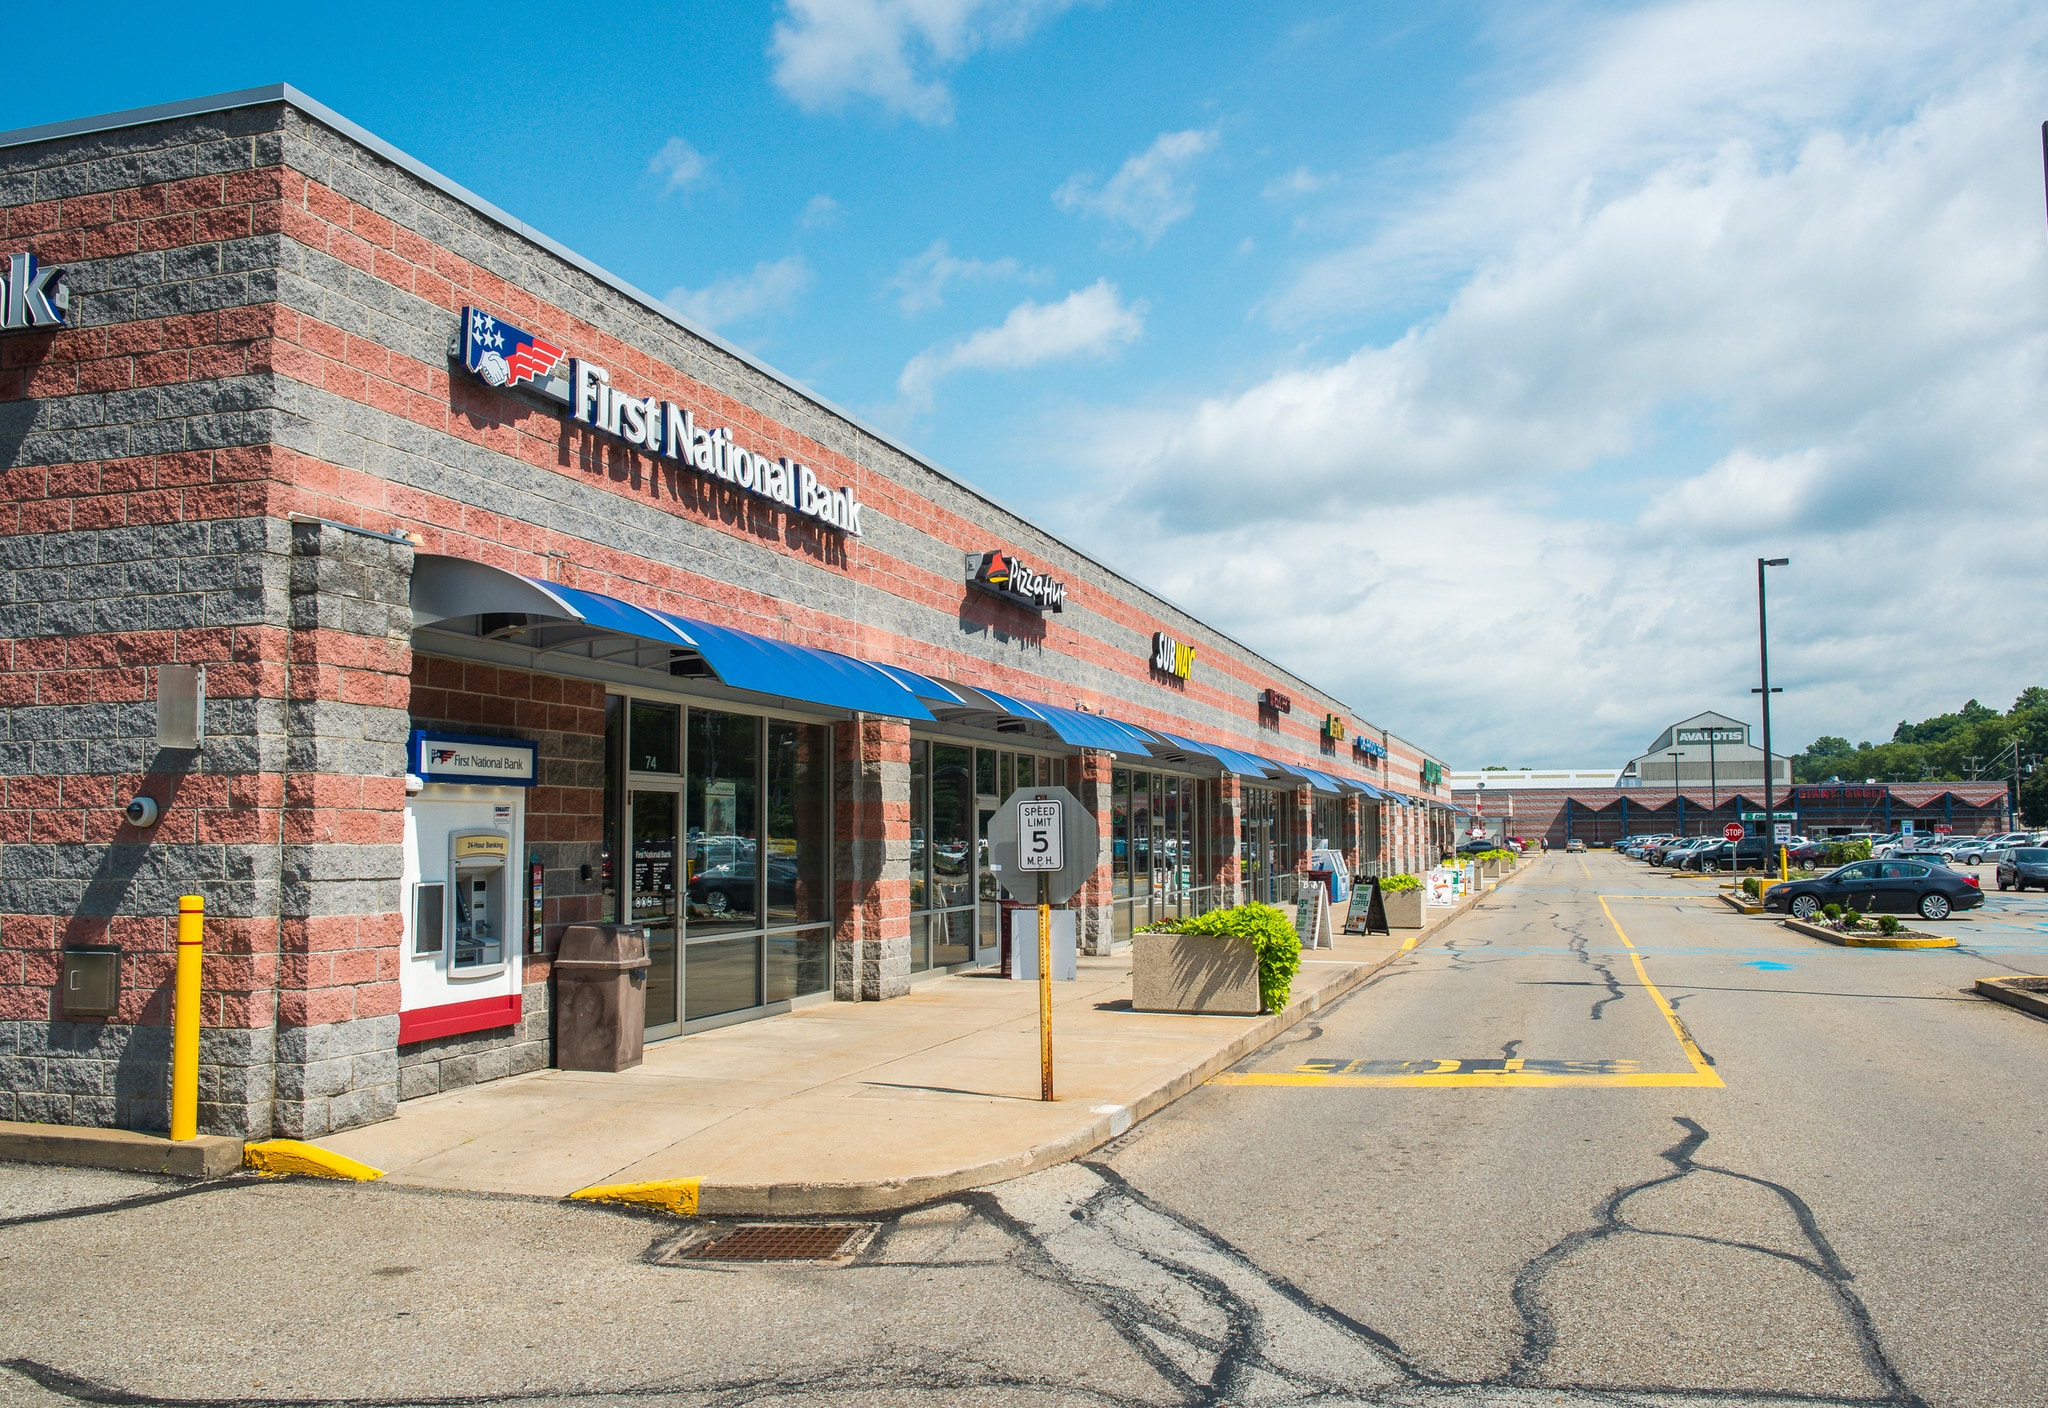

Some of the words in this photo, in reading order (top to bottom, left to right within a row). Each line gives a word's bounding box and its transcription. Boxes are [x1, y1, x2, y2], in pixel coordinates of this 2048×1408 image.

[570, 358, 660, 451] First
[663, 400, 797, 510] National
[796, 464, 863, 537] Bank
[1009, 557, 1044, 597] Pizza
[1043, 575, 1068, 610] Hut
[1156, 632, 1196, 681] SUBWAY
[1679, 731, 1743, 741] AVALOTIS
[454, 754, 470, 767] First
[471, 755, 503, 769] National
[504, 757, 523, 770] Bank
[645, 755, 657, 770] 74
[1799, 788, 1837, 799] GIANT
[1845, 787, 1887, 798] EAGLE
[1024, 807, 1056, 816] SPEED
[1027, 818, 1052, 827] LIMIT
[1725, 828, 1743, 837] STOP
[467, 841, 485, 849] 24-Hour
[485, 841, 504, 849] Banking
[1032, 830, 1049, 853] 5
[1027, 856, 1055, 865] M.P.H.
[1351, 899, 1370, 907] COFFEE
